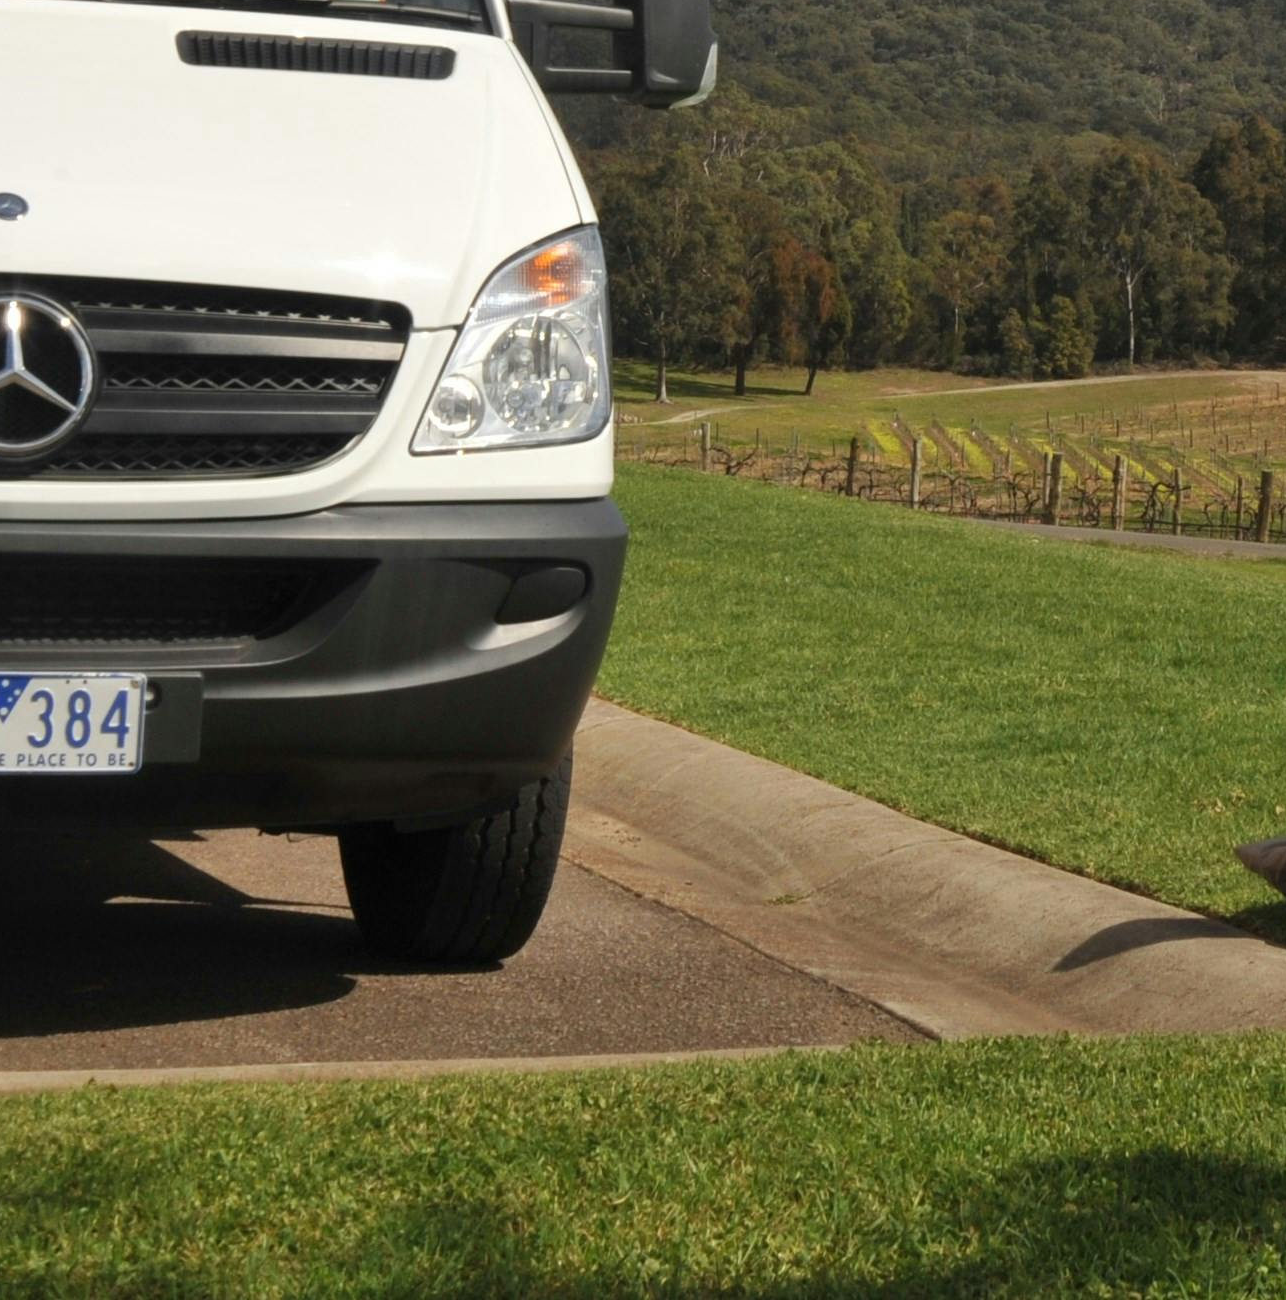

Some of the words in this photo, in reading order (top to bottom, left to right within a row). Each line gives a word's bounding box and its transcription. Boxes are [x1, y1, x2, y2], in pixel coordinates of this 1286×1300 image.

[27, 689, 130, 749] 384
[16, 753, 67, 767] PLACE
[76, 753, 98, 767] TO
[107, 753, 127, 767] BE
